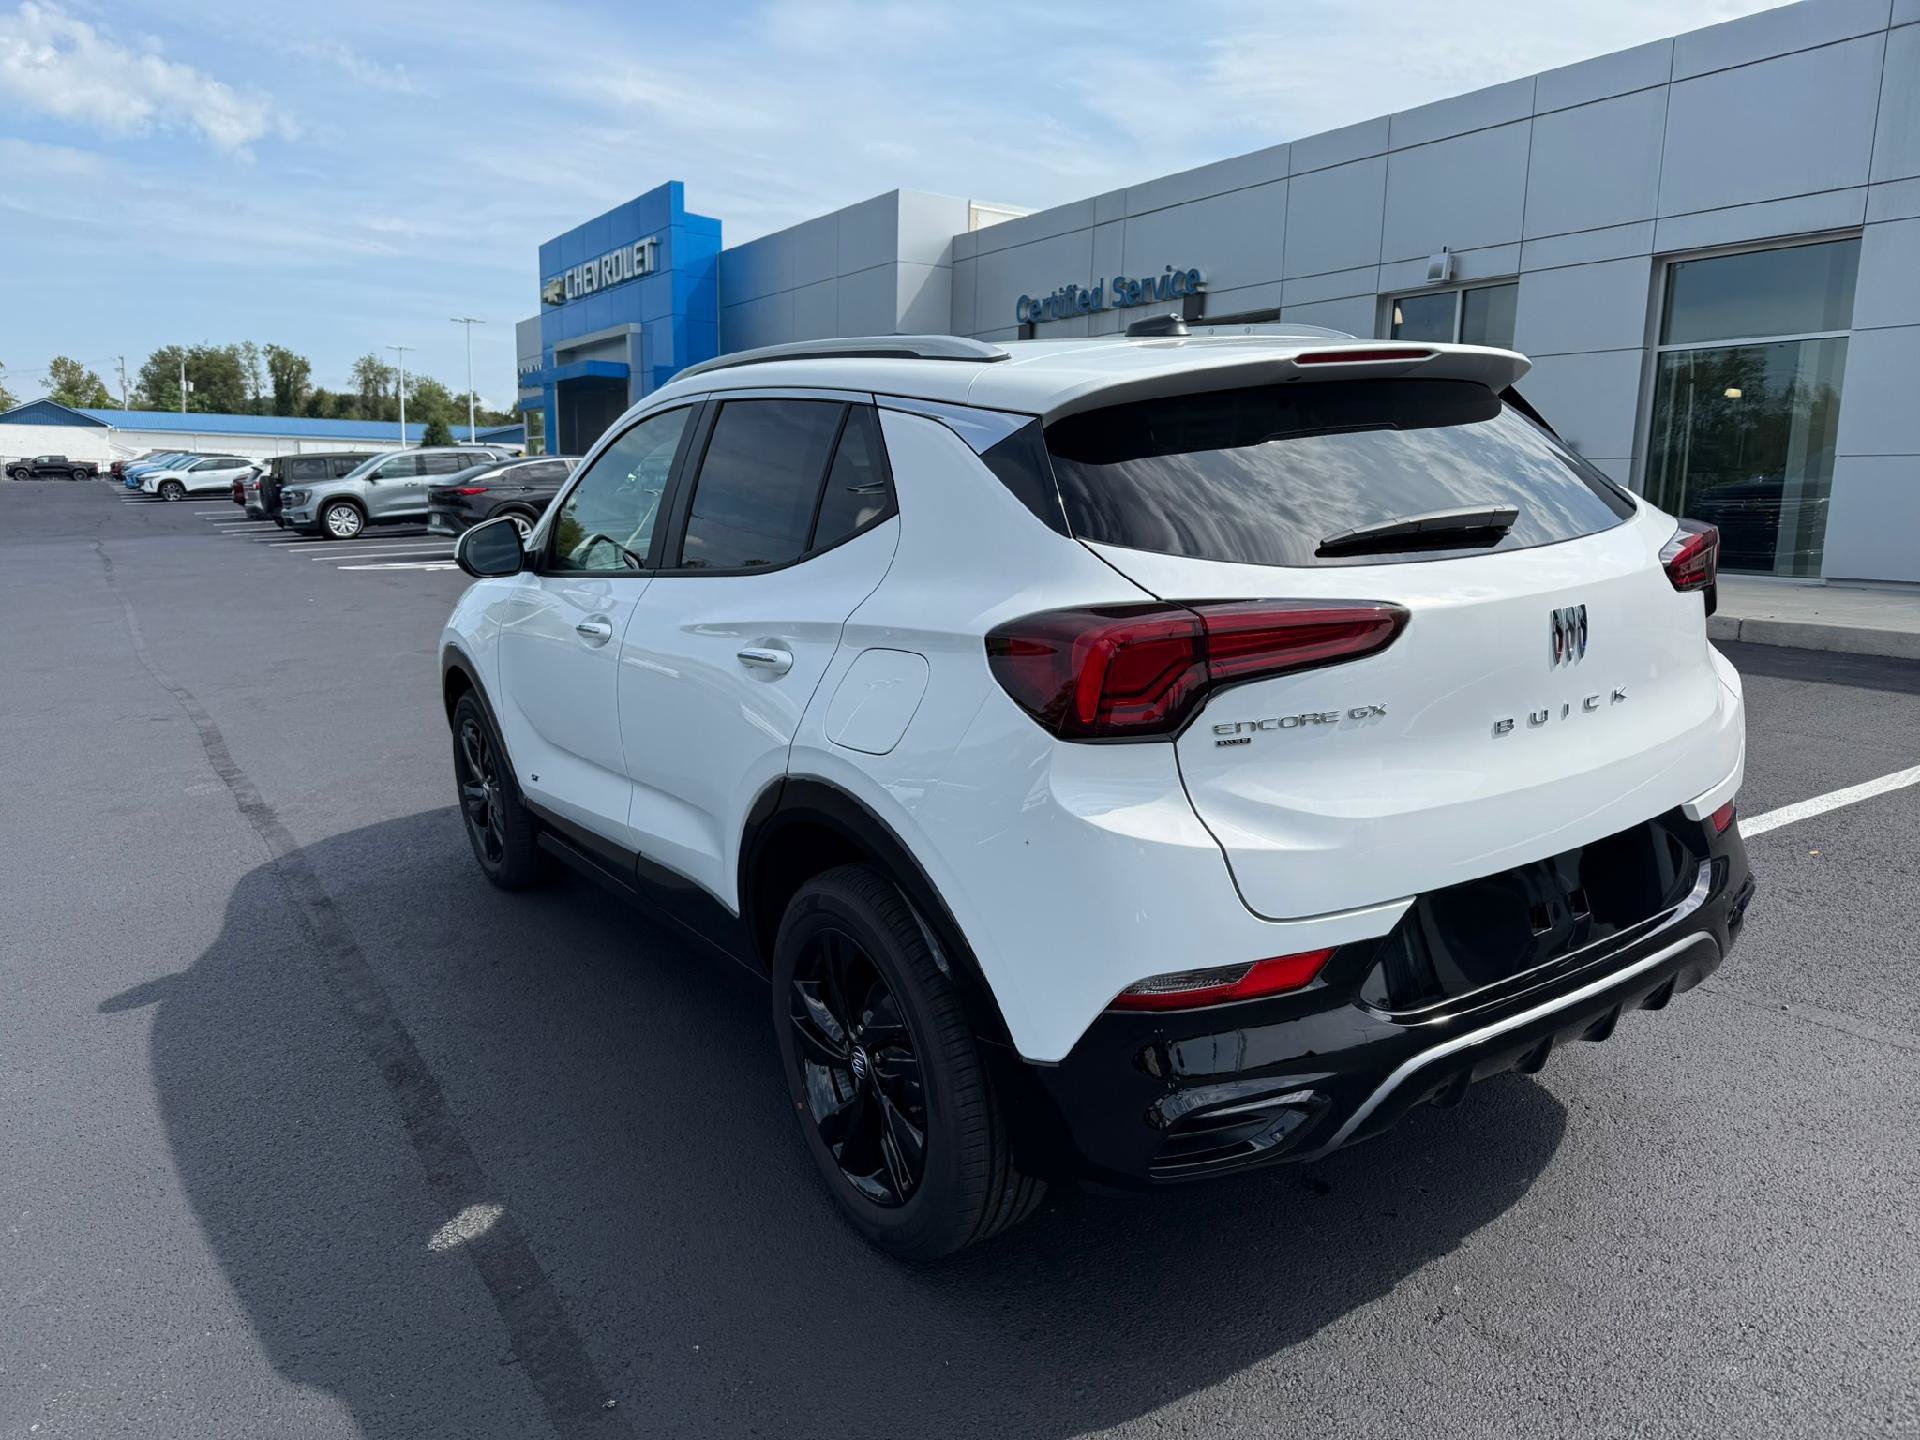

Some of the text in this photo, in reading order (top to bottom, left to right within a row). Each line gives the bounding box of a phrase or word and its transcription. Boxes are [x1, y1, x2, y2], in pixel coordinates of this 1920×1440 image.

[565, 237, 657, 299] CHEVROLET
[1016, 265, 1201, 324] Certified Service
[1214, 703, 1388, 735] ENCORE GX
[1493, 686, 1627, 735] BUICK
